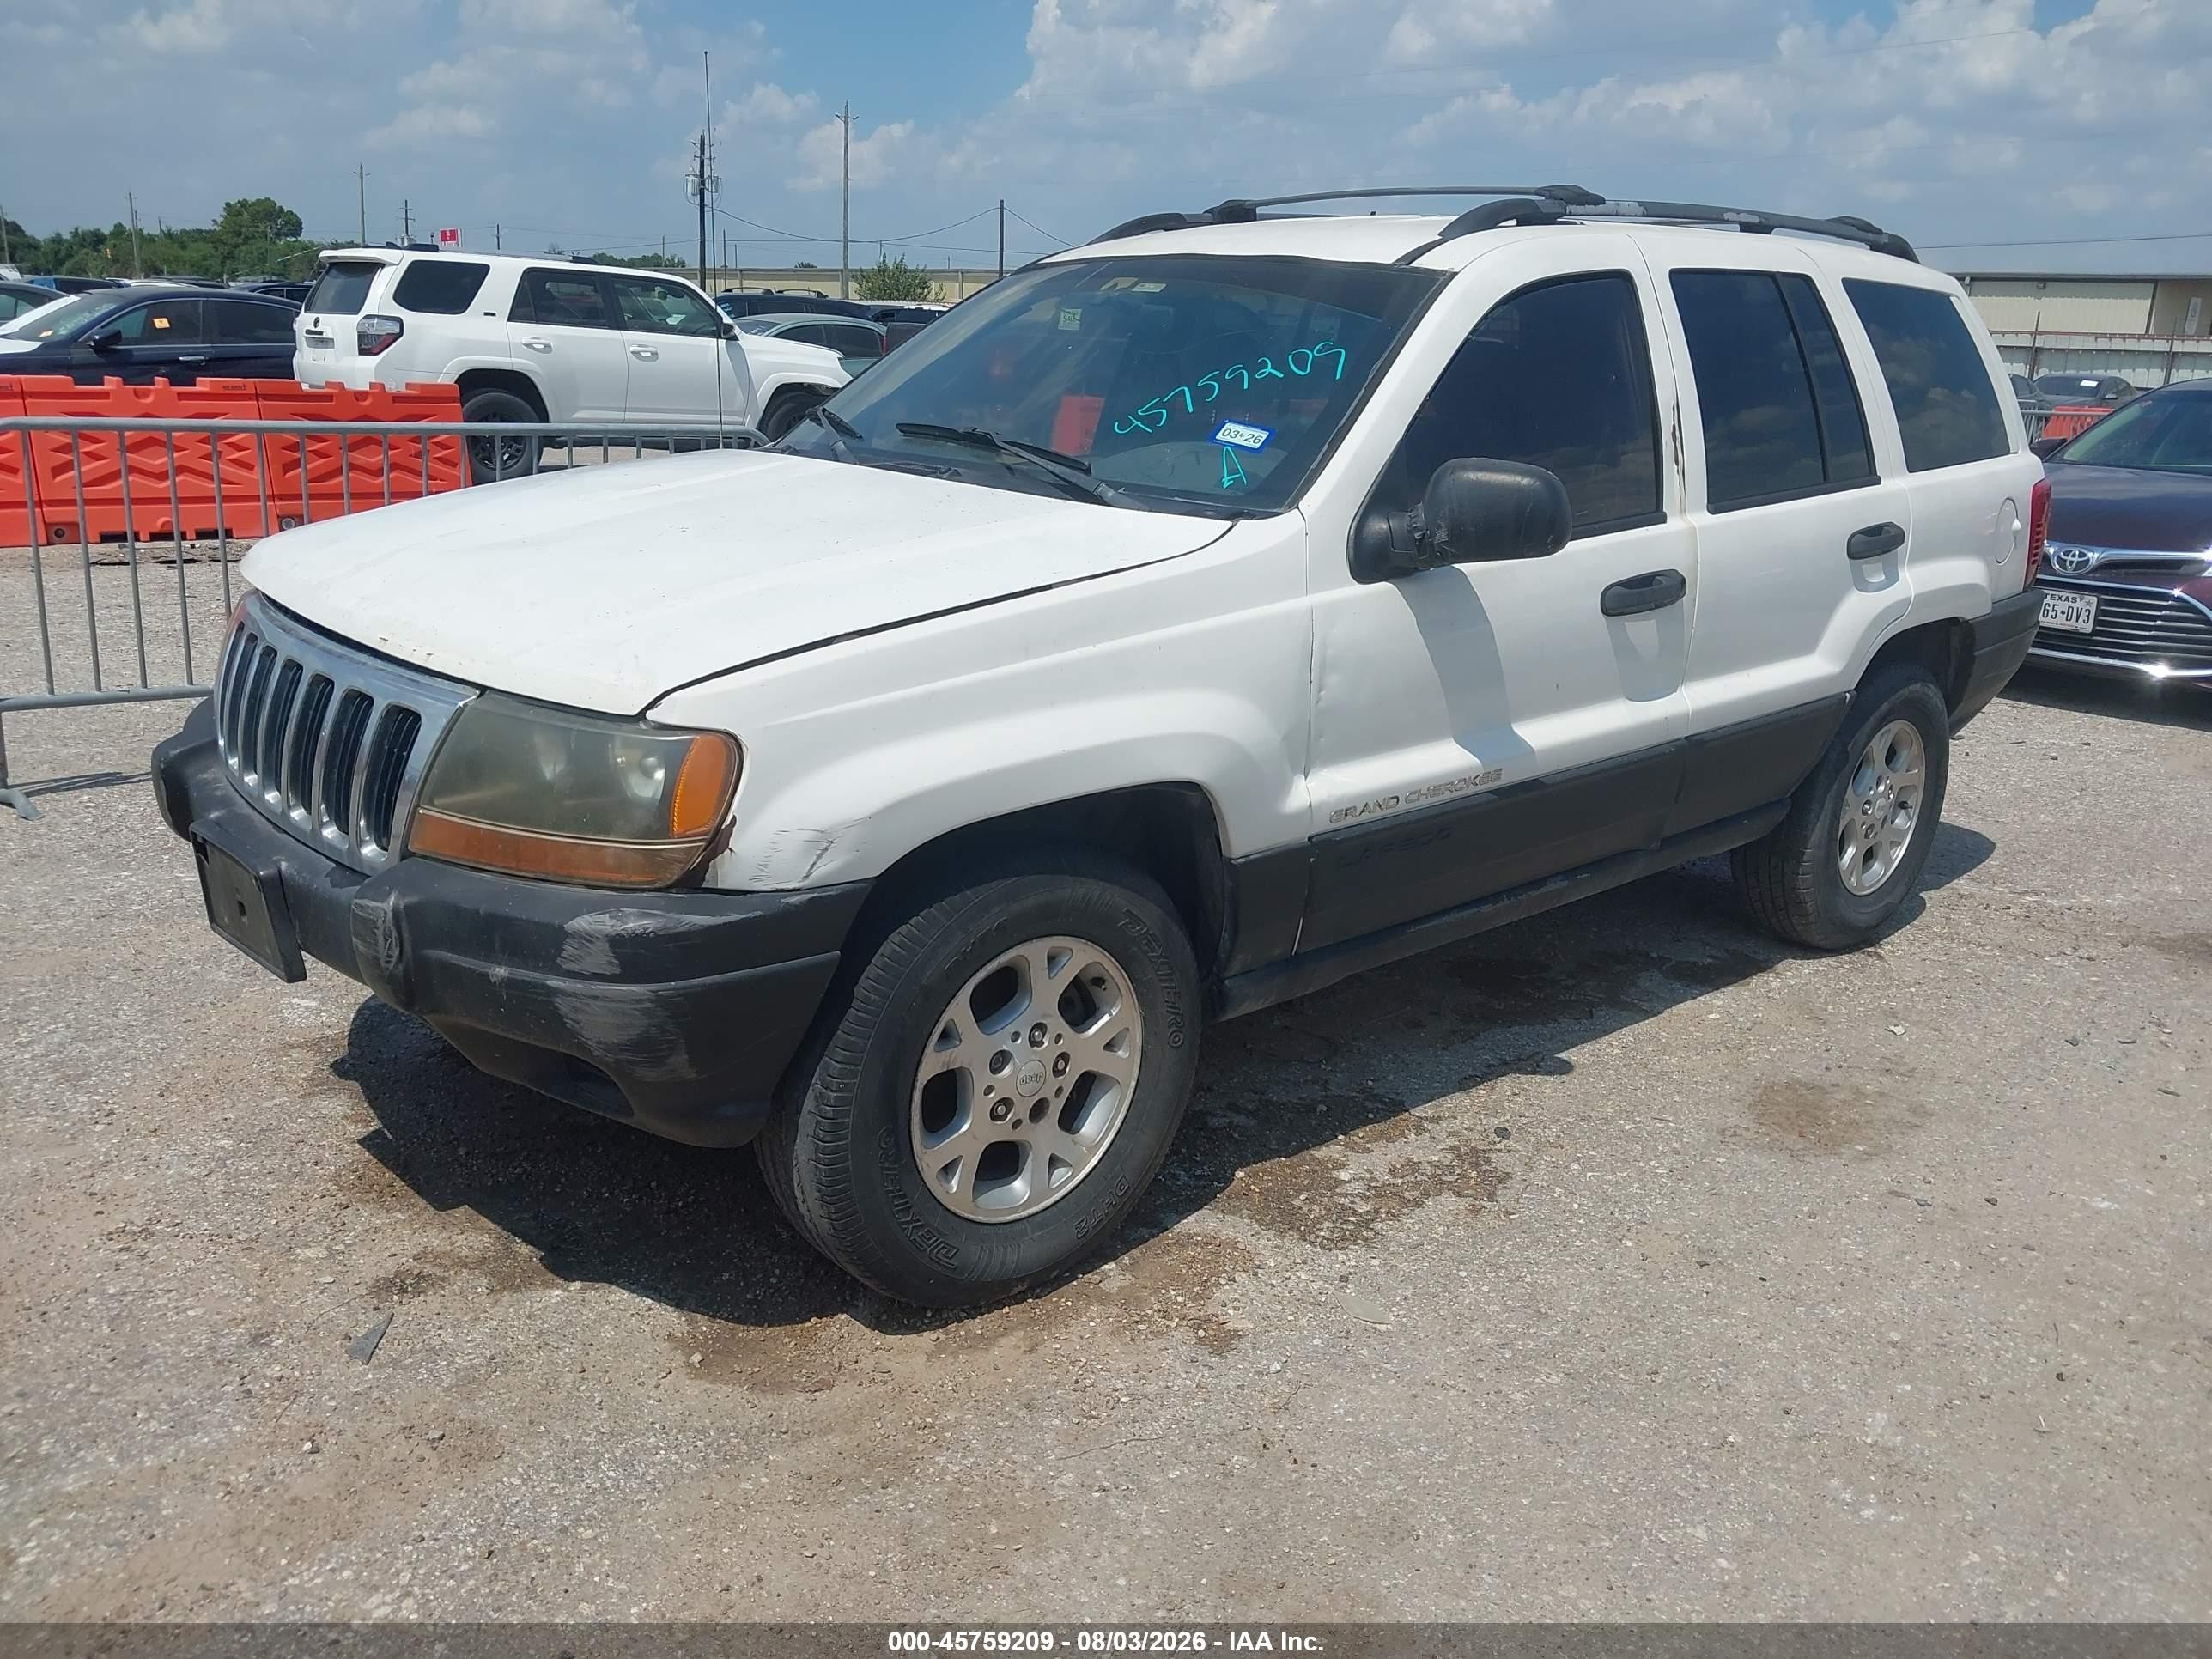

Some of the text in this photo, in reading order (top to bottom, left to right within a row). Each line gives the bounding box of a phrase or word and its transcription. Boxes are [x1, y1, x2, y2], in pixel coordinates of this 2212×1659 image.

[1114, 341, 1346, 434] 45759209
[1221, 446, 1247, 489] A
[2045, 592, 2078, 604] TEXAS
[1328, 768, 1504, 825] GRAND CHEROKEE
